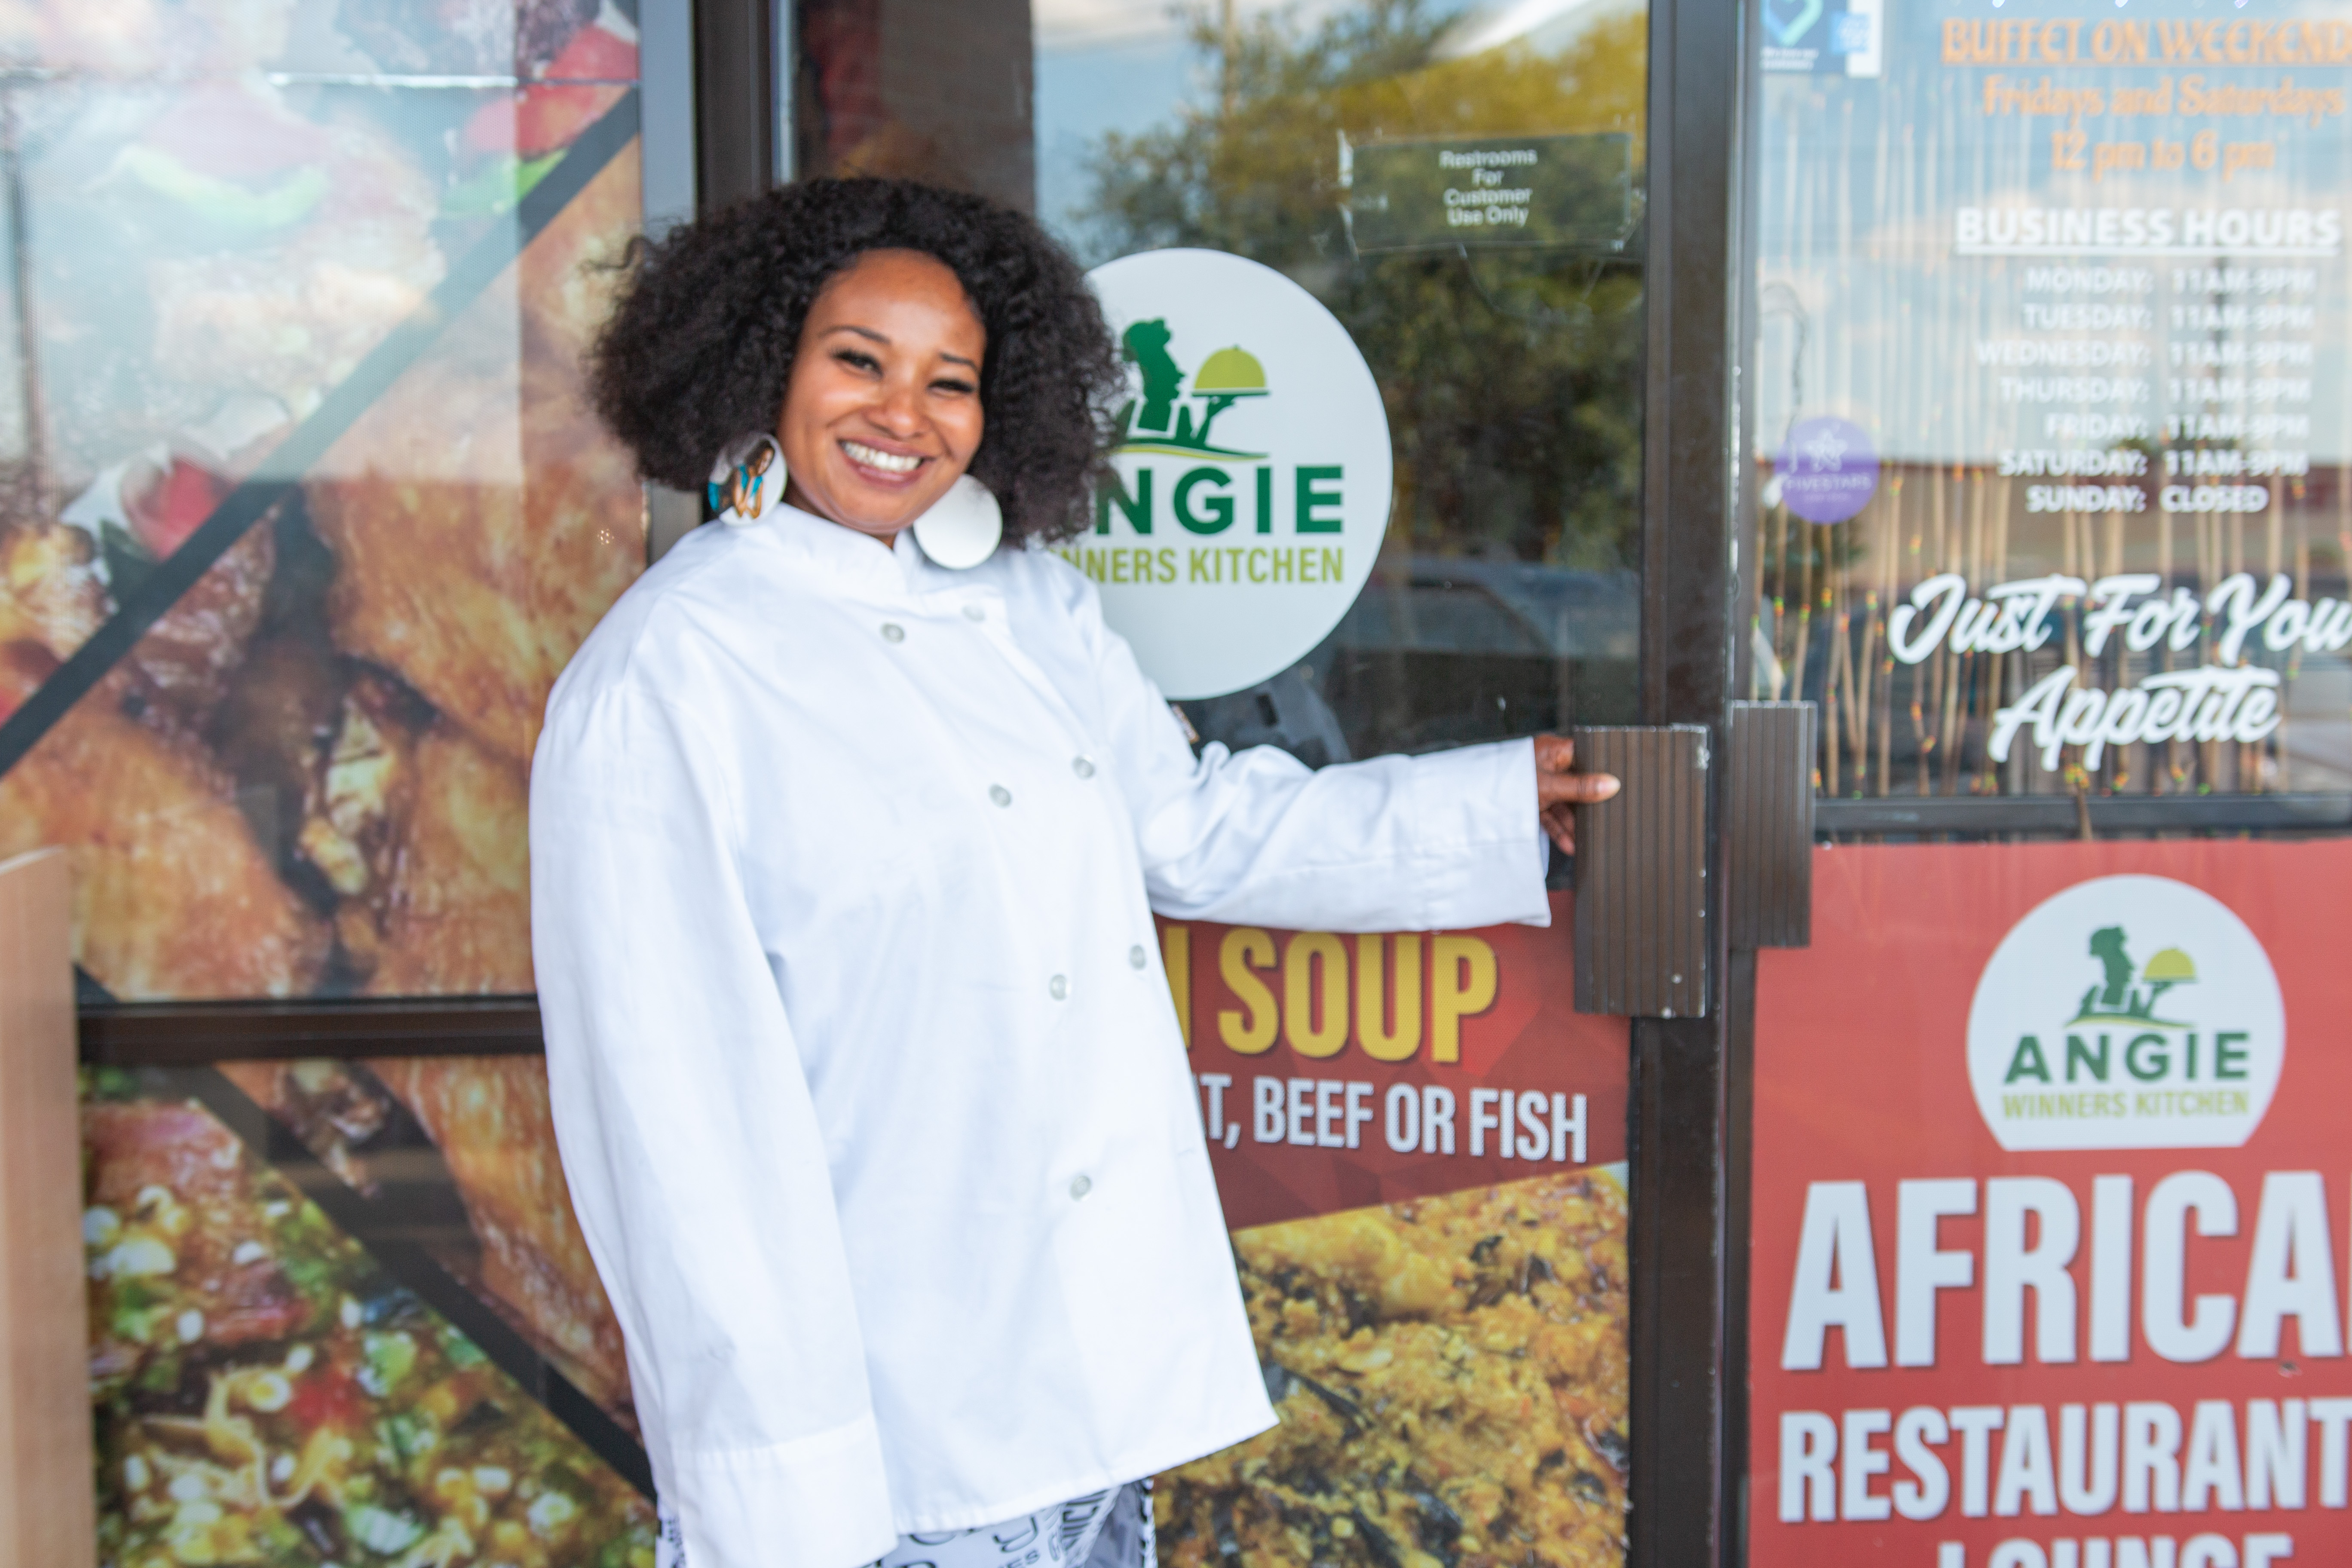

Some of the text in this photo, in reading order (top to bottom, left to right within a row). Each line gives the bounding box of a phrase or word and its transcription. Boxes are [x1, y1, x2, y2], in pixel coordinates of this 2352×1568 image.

[1942, 17, 2085, 64] BUFFET
[2090, 17, 2150, 64] ON
[1983, 73, 2345, 128] Fridays and Saturdays
[1439, 149, 1538, 168] Restrooms
[2052, 129, 2275, 182] 12 pm to 6 pm
[1472, 168, 1504, 185] For
[1443, 188, 1533, 207] Customer
[1447, 206, 1529, 227] Use Only
[1956, 208, 2341, 247] BUSINESS HOURS
[2026, 267, 2316, 294] MONDAY: 11AM-9PM
[2024, 304, 2315, 330] TUESDAY: 11AM-9PM
[1976, 341, 2313, 367] WEDNESDAY: 11AM-9PM
[2000, 376, 2311, 403] THURSDAY: 11AM-9PM
[2046, 413, 2310, 440] FRIDAY: 11AM-9PM
[1998, 449, 2309, 476] SATURDAY: 11AM-9PM
[1095, 464, 1344, 536] NGIE
[2026, 485, 2269, 513] SUNDAY: CLOSED
[1189, 547, 1344, 583] KITCHEN
[1887, 572, 2087, 665] Just
[2085, 573, 2202, 658] For
[1988, 665, 2282, 772] Appetite
[1217, 926, 1498, 1063] SOUP
[2002, 1031, 2250, 1085] ANGIE
[1253, 1075, 1374, 1148] BEEF
[1385, 1082, 1456, 1155] OR
[1469, 1087, 1587, 1163] FISH
[2002, 1089, 2250, 1120] WINNERS KITCHEN
[1780, 1170, 2352, 1371] AFRICA
[1778, 1398, 2352, 1523] RESTAURANT
